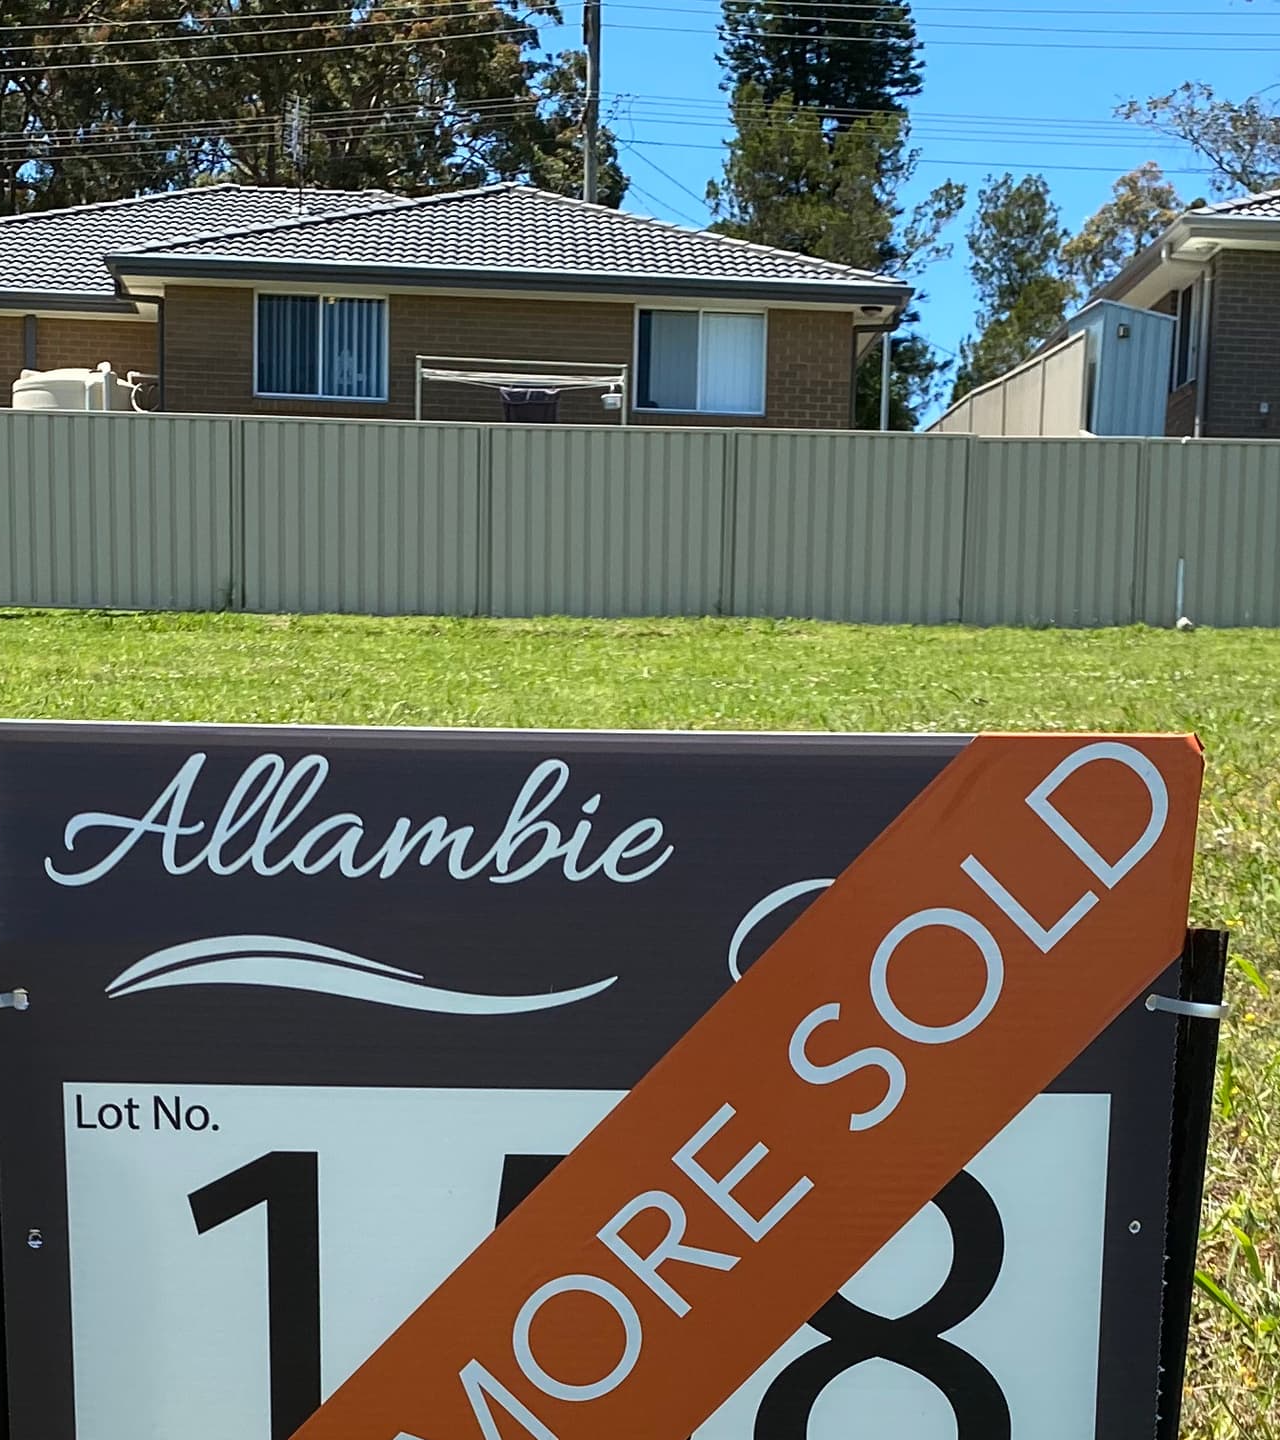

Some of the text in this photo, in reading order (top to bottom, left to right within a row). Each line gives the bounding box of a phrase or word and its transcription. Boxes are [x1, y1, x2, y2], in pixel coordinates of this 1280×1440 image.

[44, 752, 675, 887] Allambie
[788, 741, 1169, 1132] SOLD
[75, 1094, 220, 1132] Lot No.
